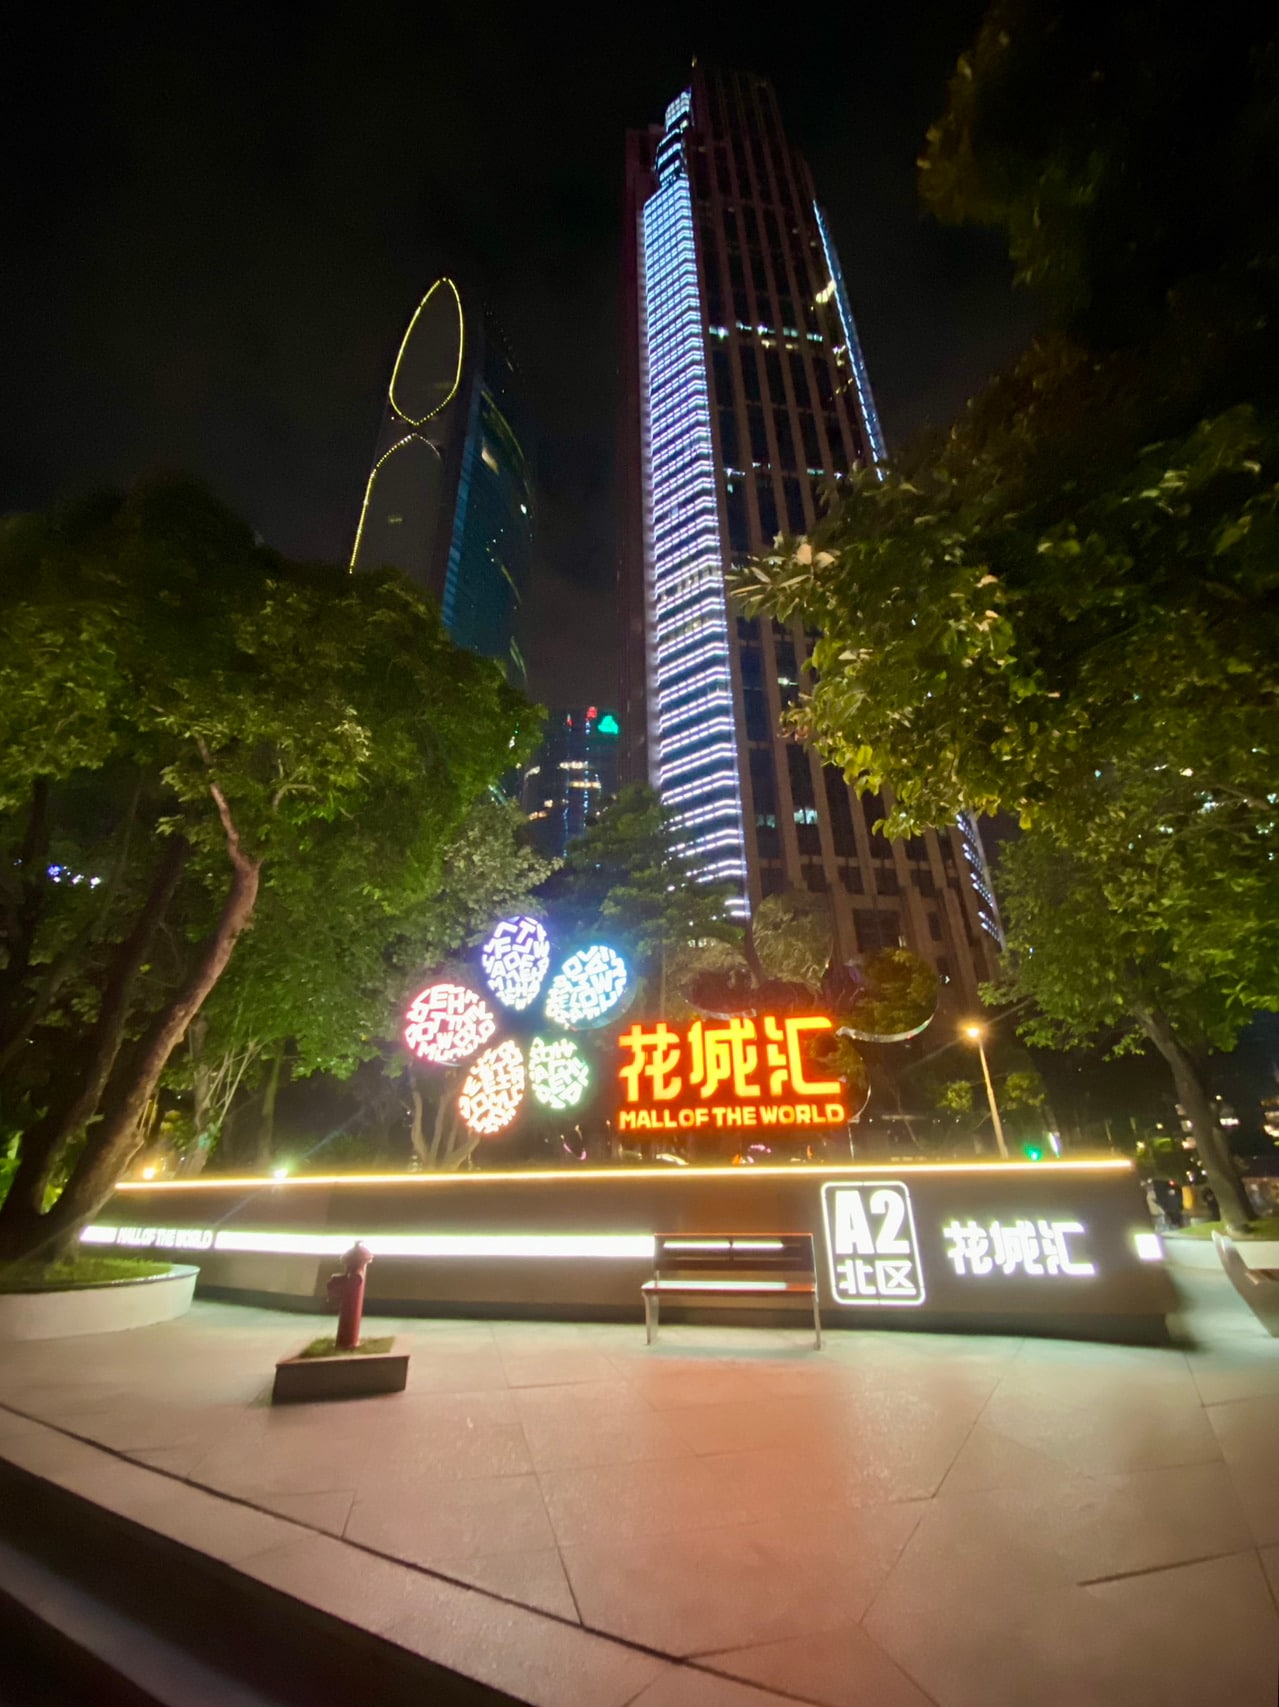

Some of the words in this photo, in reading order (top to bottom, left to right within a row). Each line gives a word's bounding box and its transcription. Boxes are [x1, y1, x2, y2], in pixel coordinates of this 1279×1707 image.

[618, 1016, 842, 1102] 花城汇
[619, 1108, 678, 1130] MALL
[679, 1106, 709, 1127] OF
[712, 1105, 757, 1126] THE
[759, 1104, 846, 1125] WORLD
[834, 1189, 911, 1254] A2
[943, 1219, 1096, 1276] 花城汇
[837, 1259, 917, 1295] 北区
